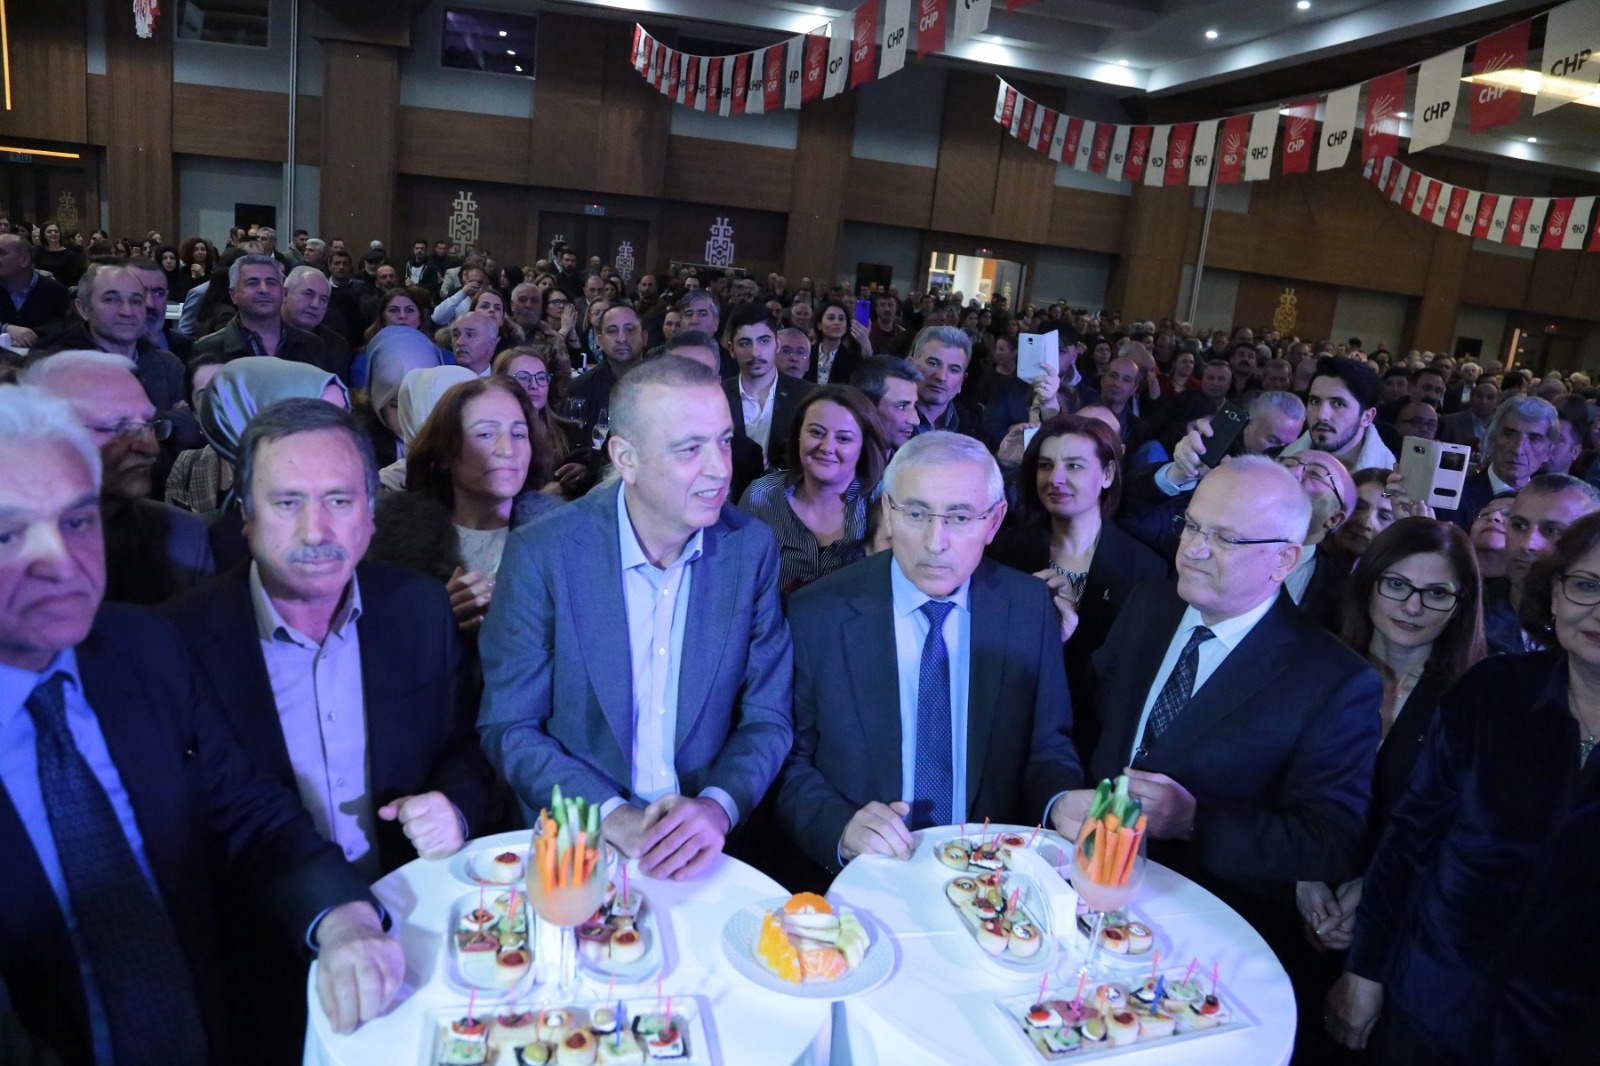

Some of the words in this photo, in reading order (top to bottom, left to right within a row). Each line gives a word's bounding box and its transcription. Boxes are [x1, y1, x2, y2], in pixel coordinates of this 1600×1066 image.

[919, 11, 939, 32] CHP
[887, 27, 905, 49] CHP
[855, 45, 868, 63] CHP
[1551, 48, 1592, 77] CHP
[1478, 86, 1508, 104] CHP
[1423, 100, 1451, 123] CHP
[1368, 121, 1393, 136] CHP
[1287, 139, 1305, 153] CHP
[1327, 130, 1348, 147] CHP
